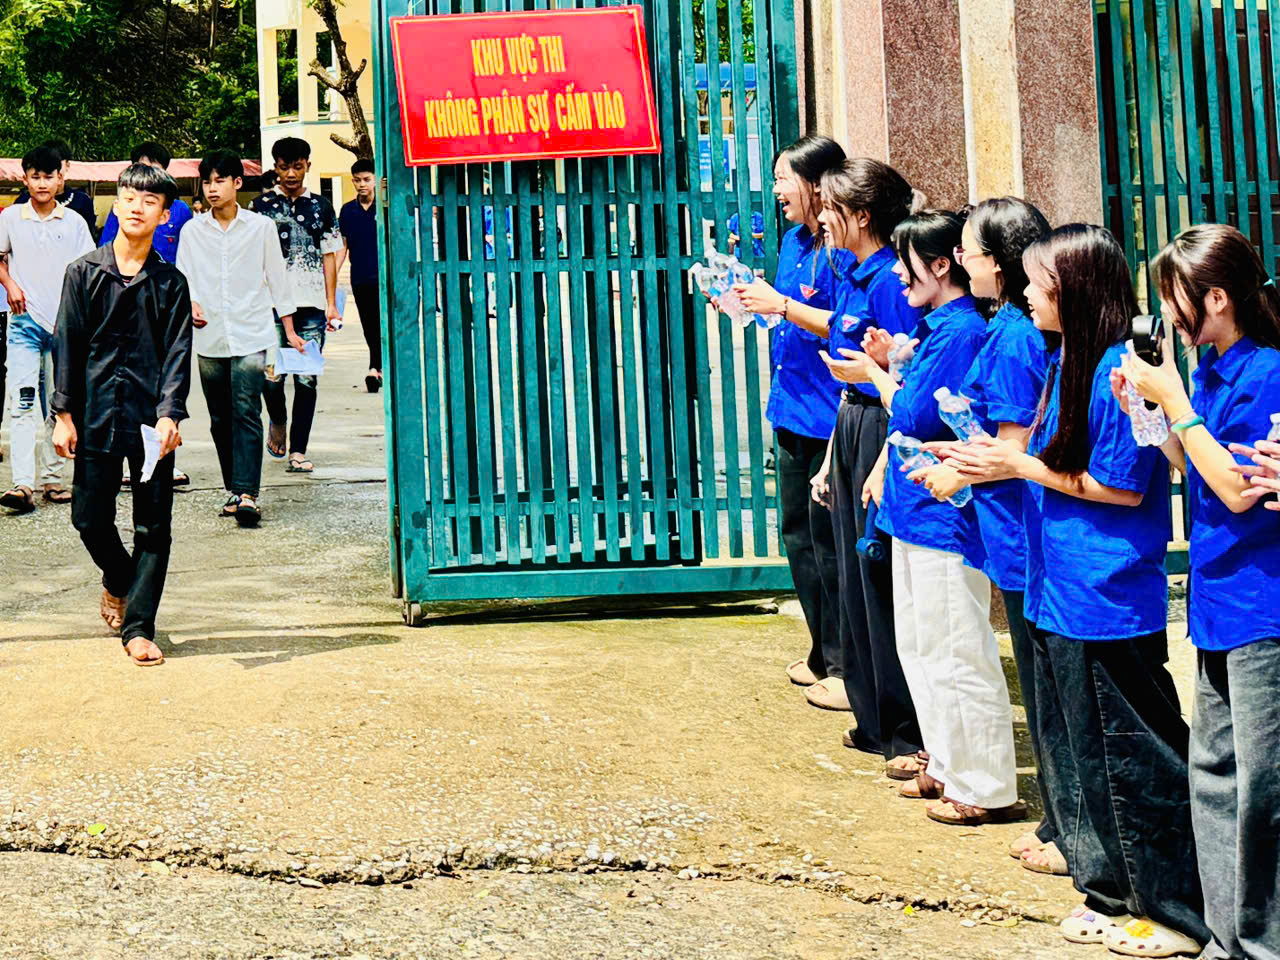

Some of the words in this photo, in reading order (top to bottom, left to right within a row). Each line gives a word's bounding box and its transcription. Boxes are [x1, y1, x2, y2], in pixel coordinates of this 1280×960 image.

[471, 38, 505, 76] KHU
[506, 33, 538, 82] VỰC
[538, 36, 566, 73] THI
[424, 90, 480, 138] KHÔNG
[480, 89, 526, 143] PHẬN
[527, 91, 550, 138] SỰ
[555, 82, 592, 132] CẤM
[592, 84, 627, 130] VÀO
